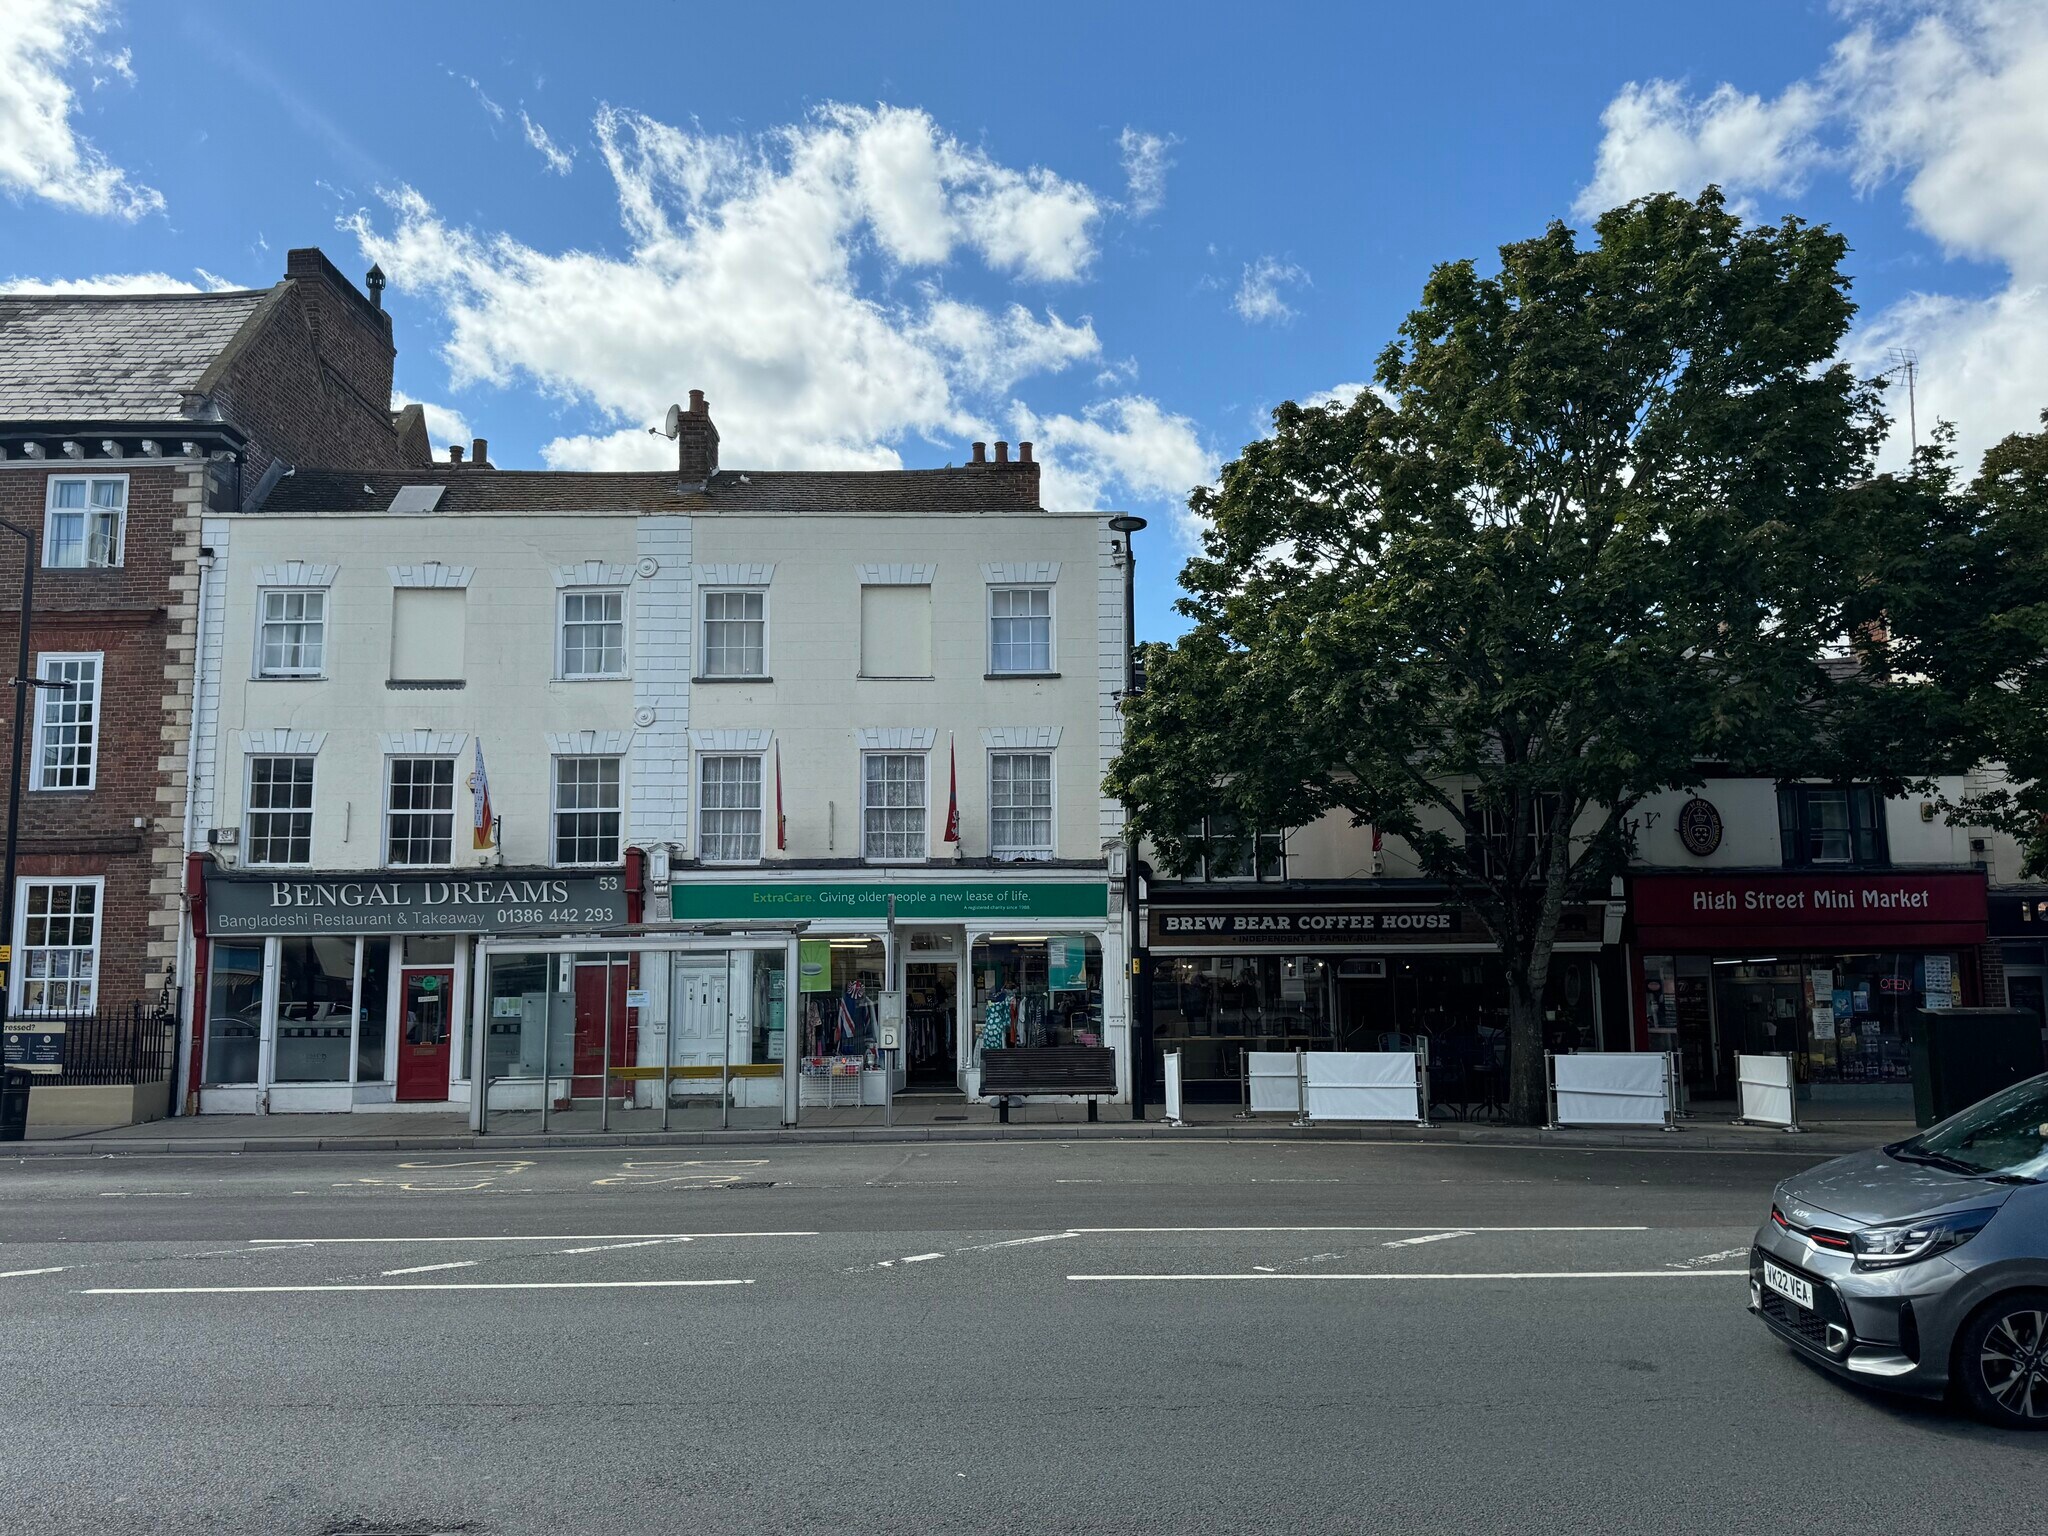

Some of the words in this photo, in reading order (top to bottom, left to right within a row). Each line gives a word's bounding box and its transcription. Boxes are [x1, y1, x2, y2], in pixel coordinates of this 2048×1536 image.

[599, 877, 618, 890] 53
[270, 882, 411, 906] BENGAL
[422, 880, 569, 905] DREAMS
[753, 892, 815, 902] ExtraCare.
[819, 892, 856, 904] Giving
[858, 892, 886, 902] older
[966, 891, 993, 901] lease
[997, 890, 1008, 901] of
[1012, 890, 1031, 901] life.
[1693, 890, 1737, 910] High
[1744, 890, 1805, 910] Street
[1814, 889, 1855, 908] Mini
[1862, 889, 1928, 908] Market
[219, 913, 308, 930] Bangladeshi
[314, 913, 392, 926] Restaurant
[398, 913, 407, 925] &
[413, 912, 485, 930] Takeaway
[497, 909, 543, 923] 01386
[549, 908, 578, 922] 442
[585, 908, 613, 922] 293
[1166, 916, 1226, 930] BREW
[1234, 916, 1290, 930] BEAR
[1298, 916, 1374, 929] COFFEE
[1382, 915, 1450, 928] HOUSE
[1880, 978, 1912, 990] OPEN
[885, 1034, 894, 1045] D
[1767, 1264, 1788, 1292] VK22
[1790, 1276, 1808, 1303] VEA
